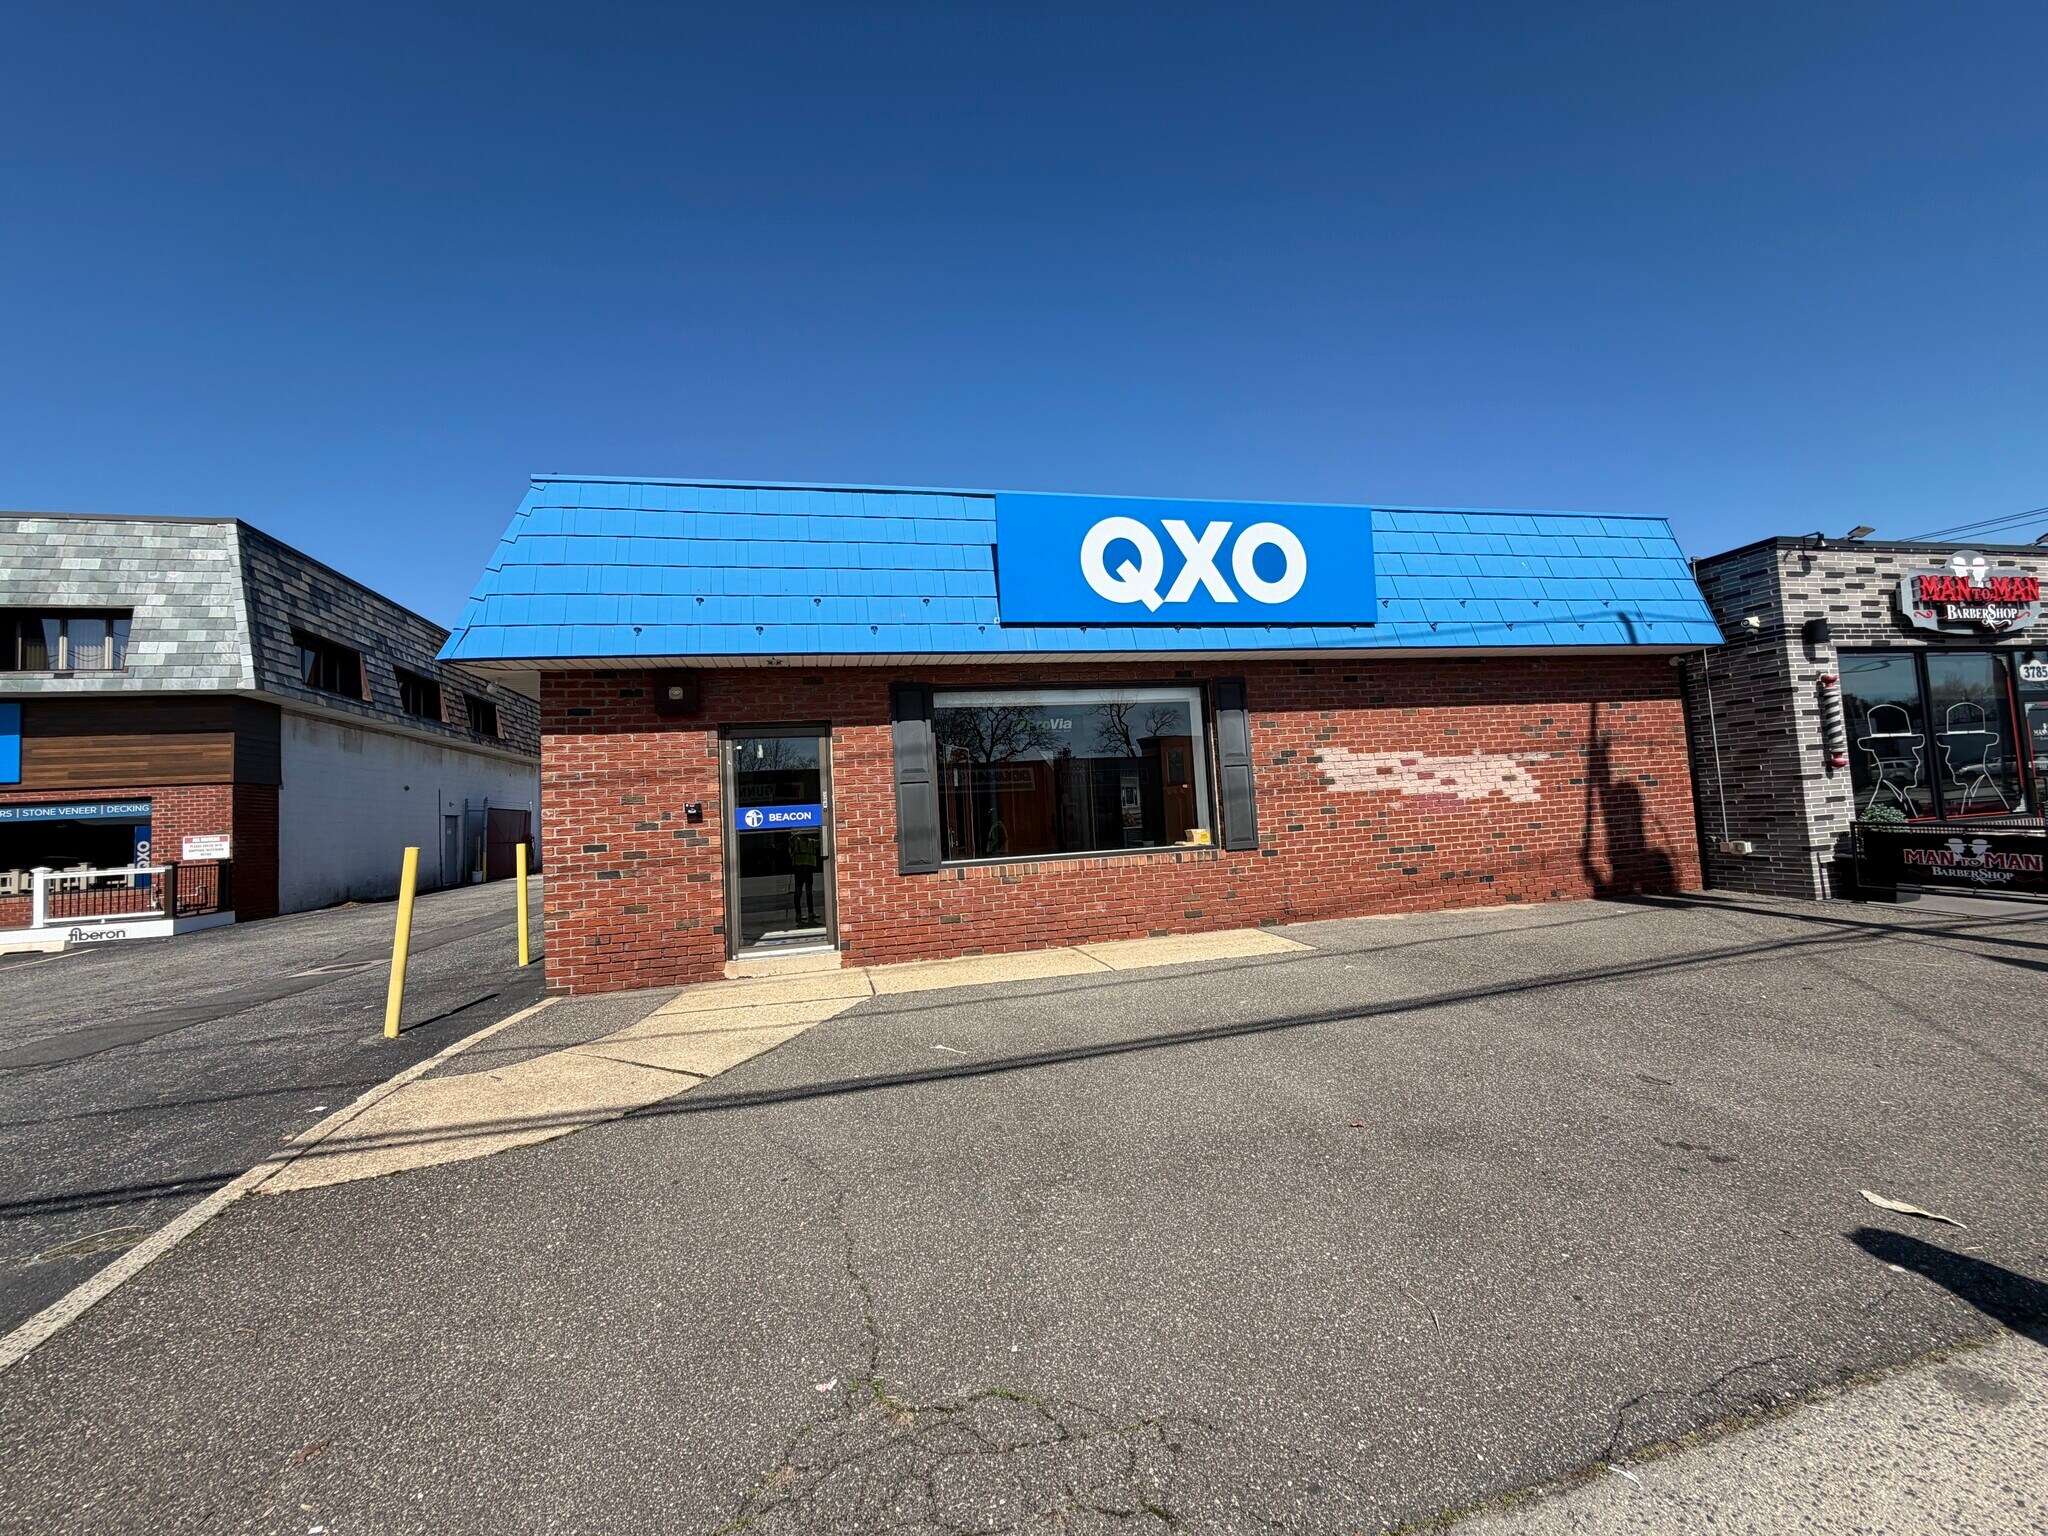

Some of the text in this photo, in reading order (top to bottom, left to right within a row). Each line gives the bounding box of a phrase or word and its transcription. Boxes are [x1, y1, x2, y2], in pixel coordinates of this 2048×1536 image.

[1080, 516, 1307, 613] QXO
[1920, 575, 2039, 602] MAN TO MAN
[2023, 666, 2048, 678] 3785
[22, 808, 56, 817] STONE
[58, 806, 97, 815] VENEER
[106, 804, 150, 814] DECKING
[769, 811, 812, 822] BEACON
[136, 840, 150, 869] QXO
[1903, 849, 2043, 871] MAN TO MAN
[68, 927, 126, 941] fiberon
